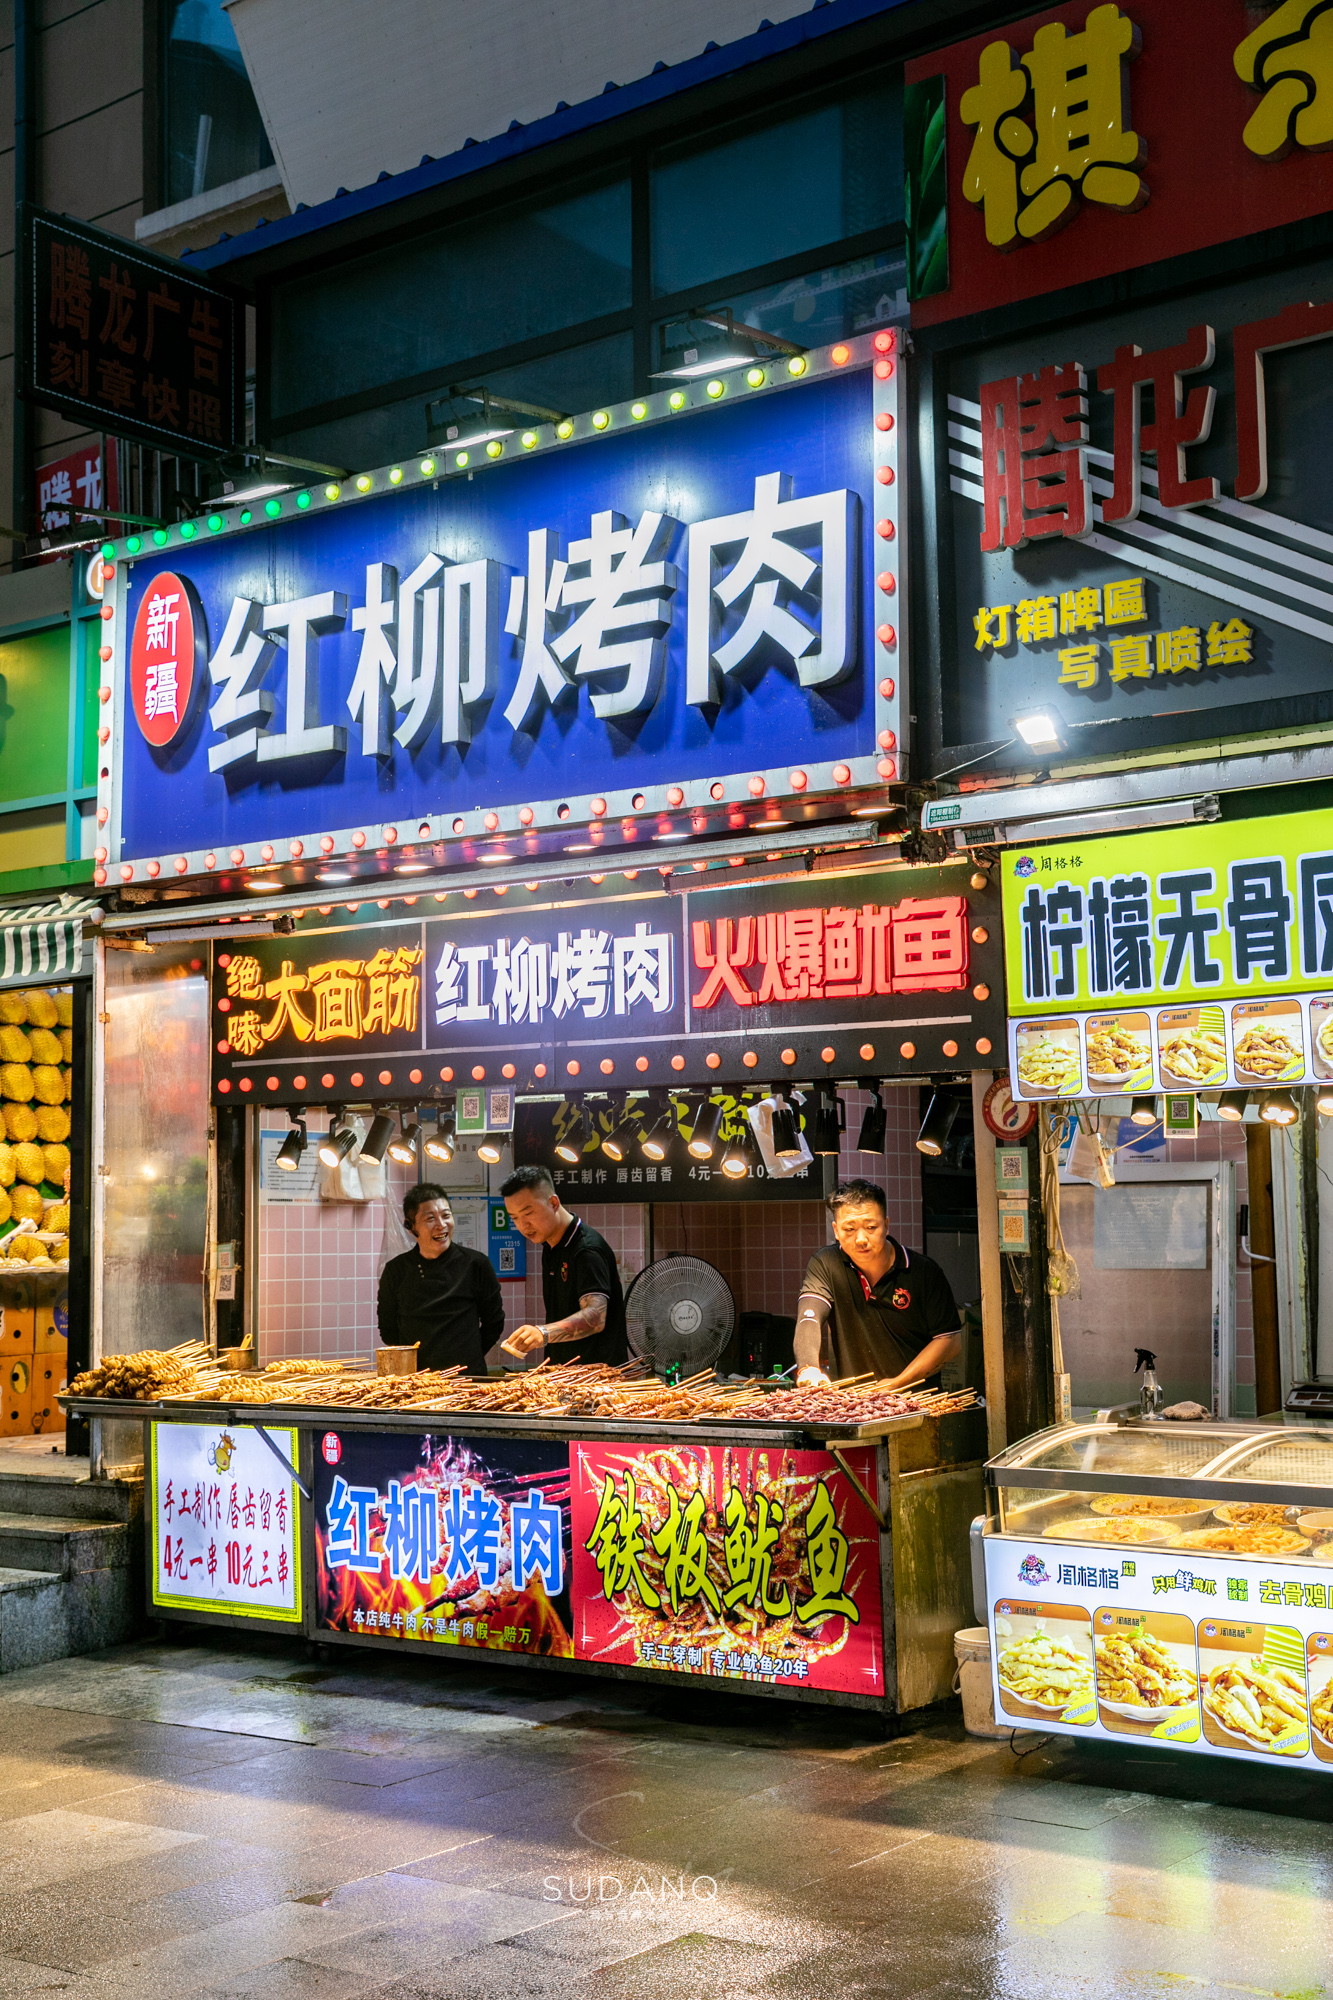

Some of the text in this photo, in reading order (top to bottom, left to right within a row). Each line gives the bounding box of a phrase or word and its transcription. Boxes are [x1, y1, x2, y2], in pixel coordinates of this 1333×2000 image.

[50, 241, 224, 386] 腾龙广告
[49, 340, 223, 442] 刻章快照
[208, 471, 860, 774] 红柳烤肉
[973, 577, 1148, 653] 灯箱牌匾
[146, 593, 181, 725] 新疆
[1057, 617, 1256, 690] 写真喷绘
[1040, 855, 1084, 872] 周格格
[262, 946, 423, 1044] 大面筋
[434, 921, 675, 1027] 红柳烤肉
[691, 895, 970, 1008] 火爆鱿鱼
[553, 1168, 608, 1185] 手工制作
[616, 1165, 673, 1184] 唇齿留香
[325, 1434, 340, 1463] 新疆
[163, 1478, 288, 1535] 手工制作 唇齿留香
[326, 1475, 564, 1597] 红柳烤肉
[163, 1534, 289, 1597] 4元一串 10元三串
[586, 1468, 861, 1626] 铁板鱿鱼
[1057, 1564, 1119, 1589] 周格格
[1152, 1569, 1217, 1596] 只用鲜鸡爪
[352, 1606, 418, 1632] 本店纯牛肉
[641, 1642, 809, 1680] 手工穿制 专业鱿鱼20年
